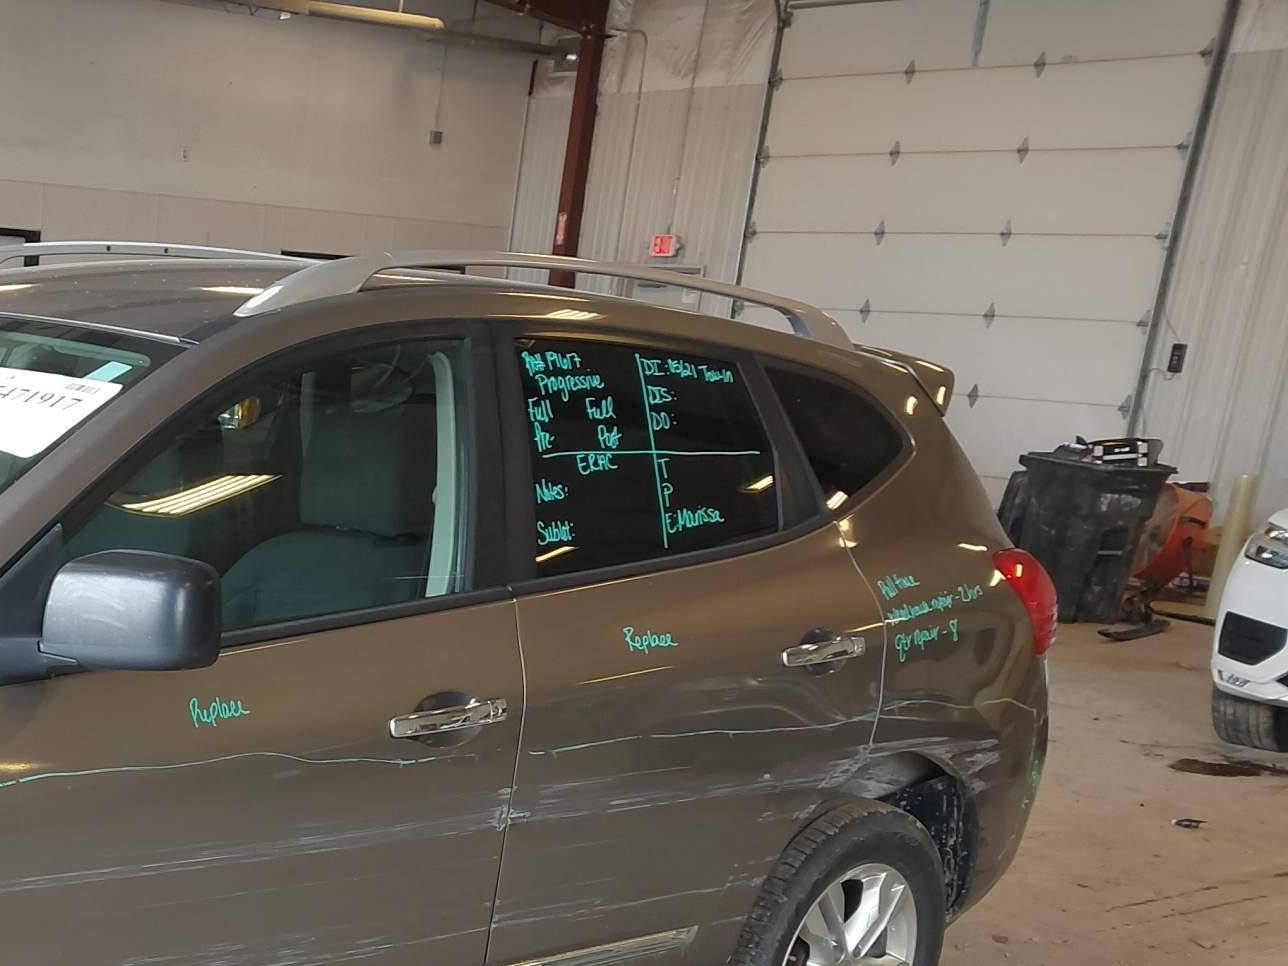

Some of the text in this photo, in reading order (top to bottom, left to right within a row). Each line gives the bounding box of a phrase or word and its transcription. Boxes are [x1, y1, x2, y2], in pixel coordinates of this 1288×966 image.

[535, 373, 606, 402] Progressive
[527, 396, 554, 423] Full
[585, 395, 617, 420] Full
[621, 626, 680, 655] Replace
[189, 696, 251, 729] Replace
